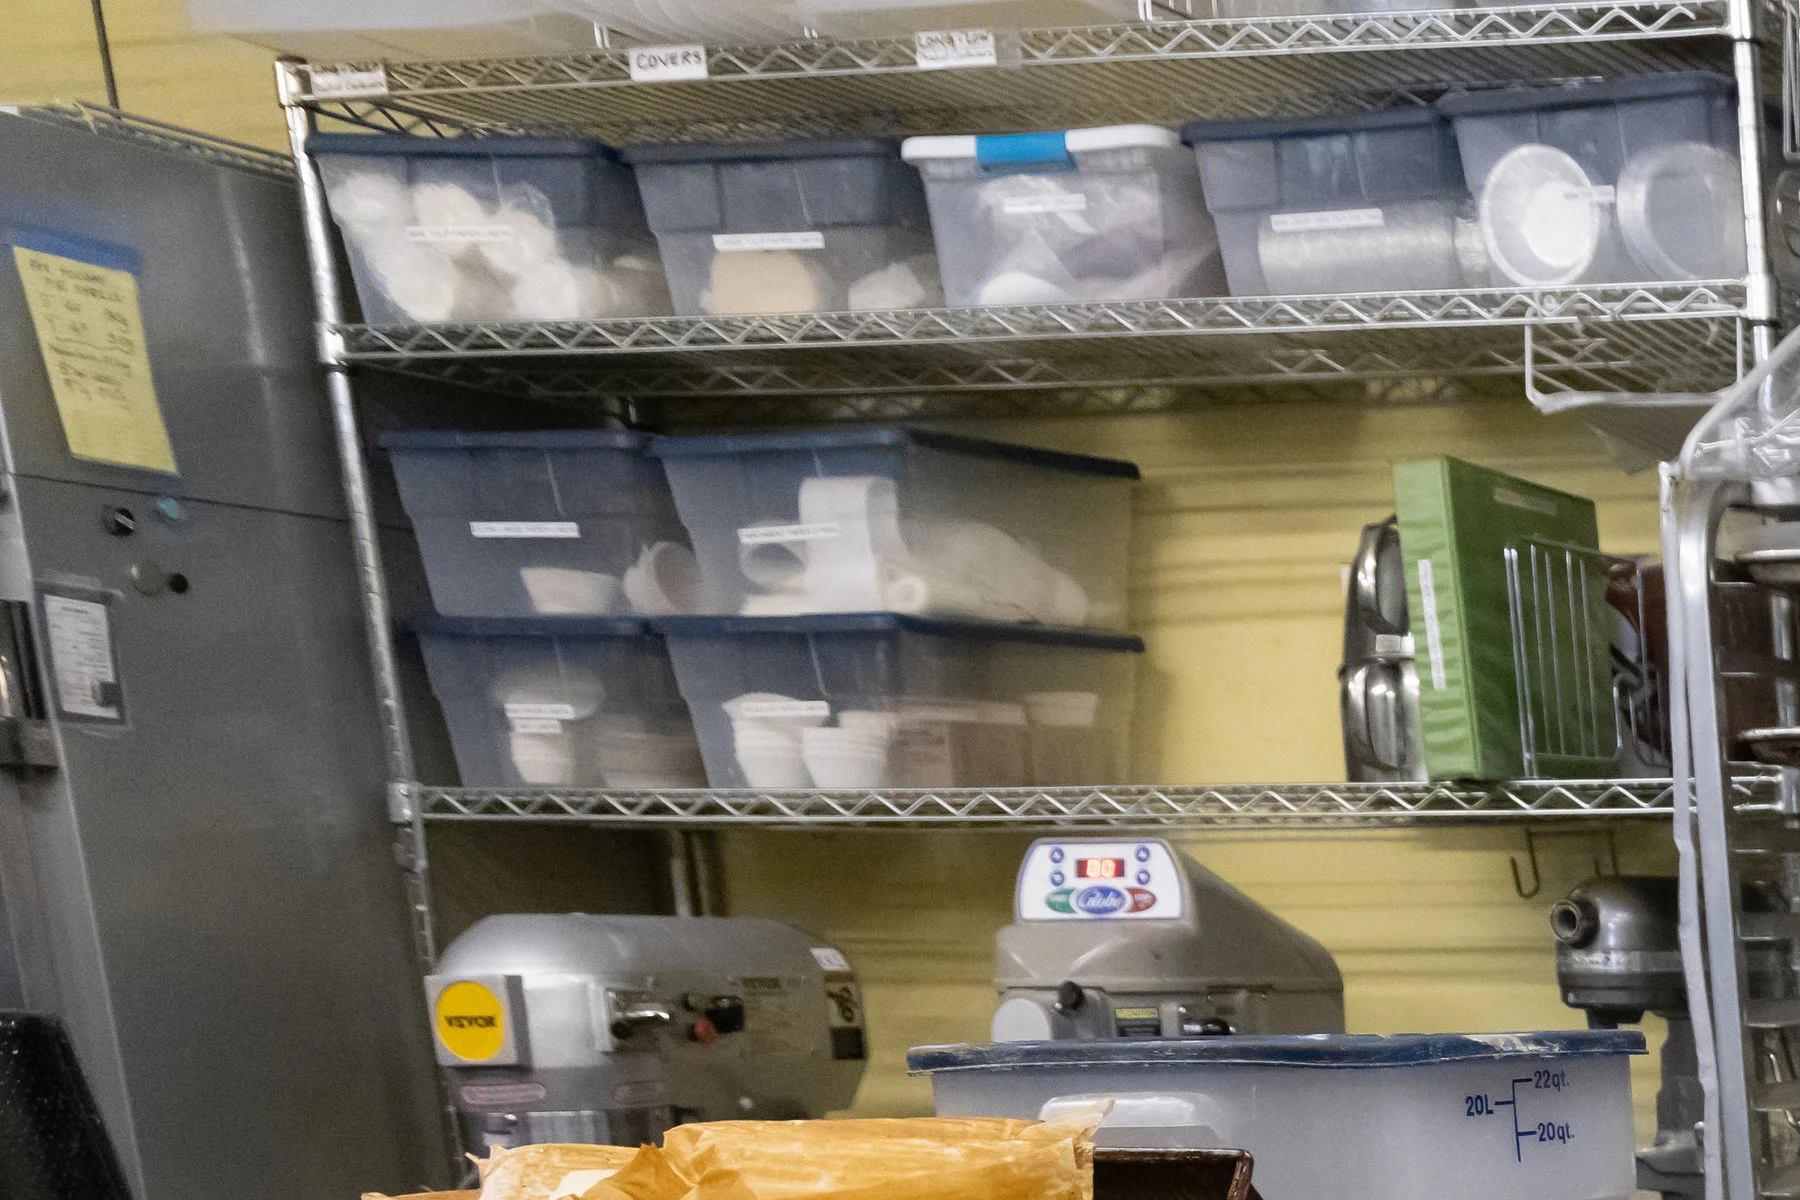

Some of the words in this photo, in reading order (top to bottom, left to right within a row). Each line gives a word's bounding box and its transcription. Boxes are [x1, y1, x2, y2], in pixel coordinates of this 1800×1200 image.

[635, 50, 703, 69] COVERS
[444, 1015, 497, 1028] VEVOR
[1534, 1069, 1570, 1092] 22qt.
[1465, 1095, 1494, 1116] 20L
[1537, 1122, 1575, 1143] 20qt.
